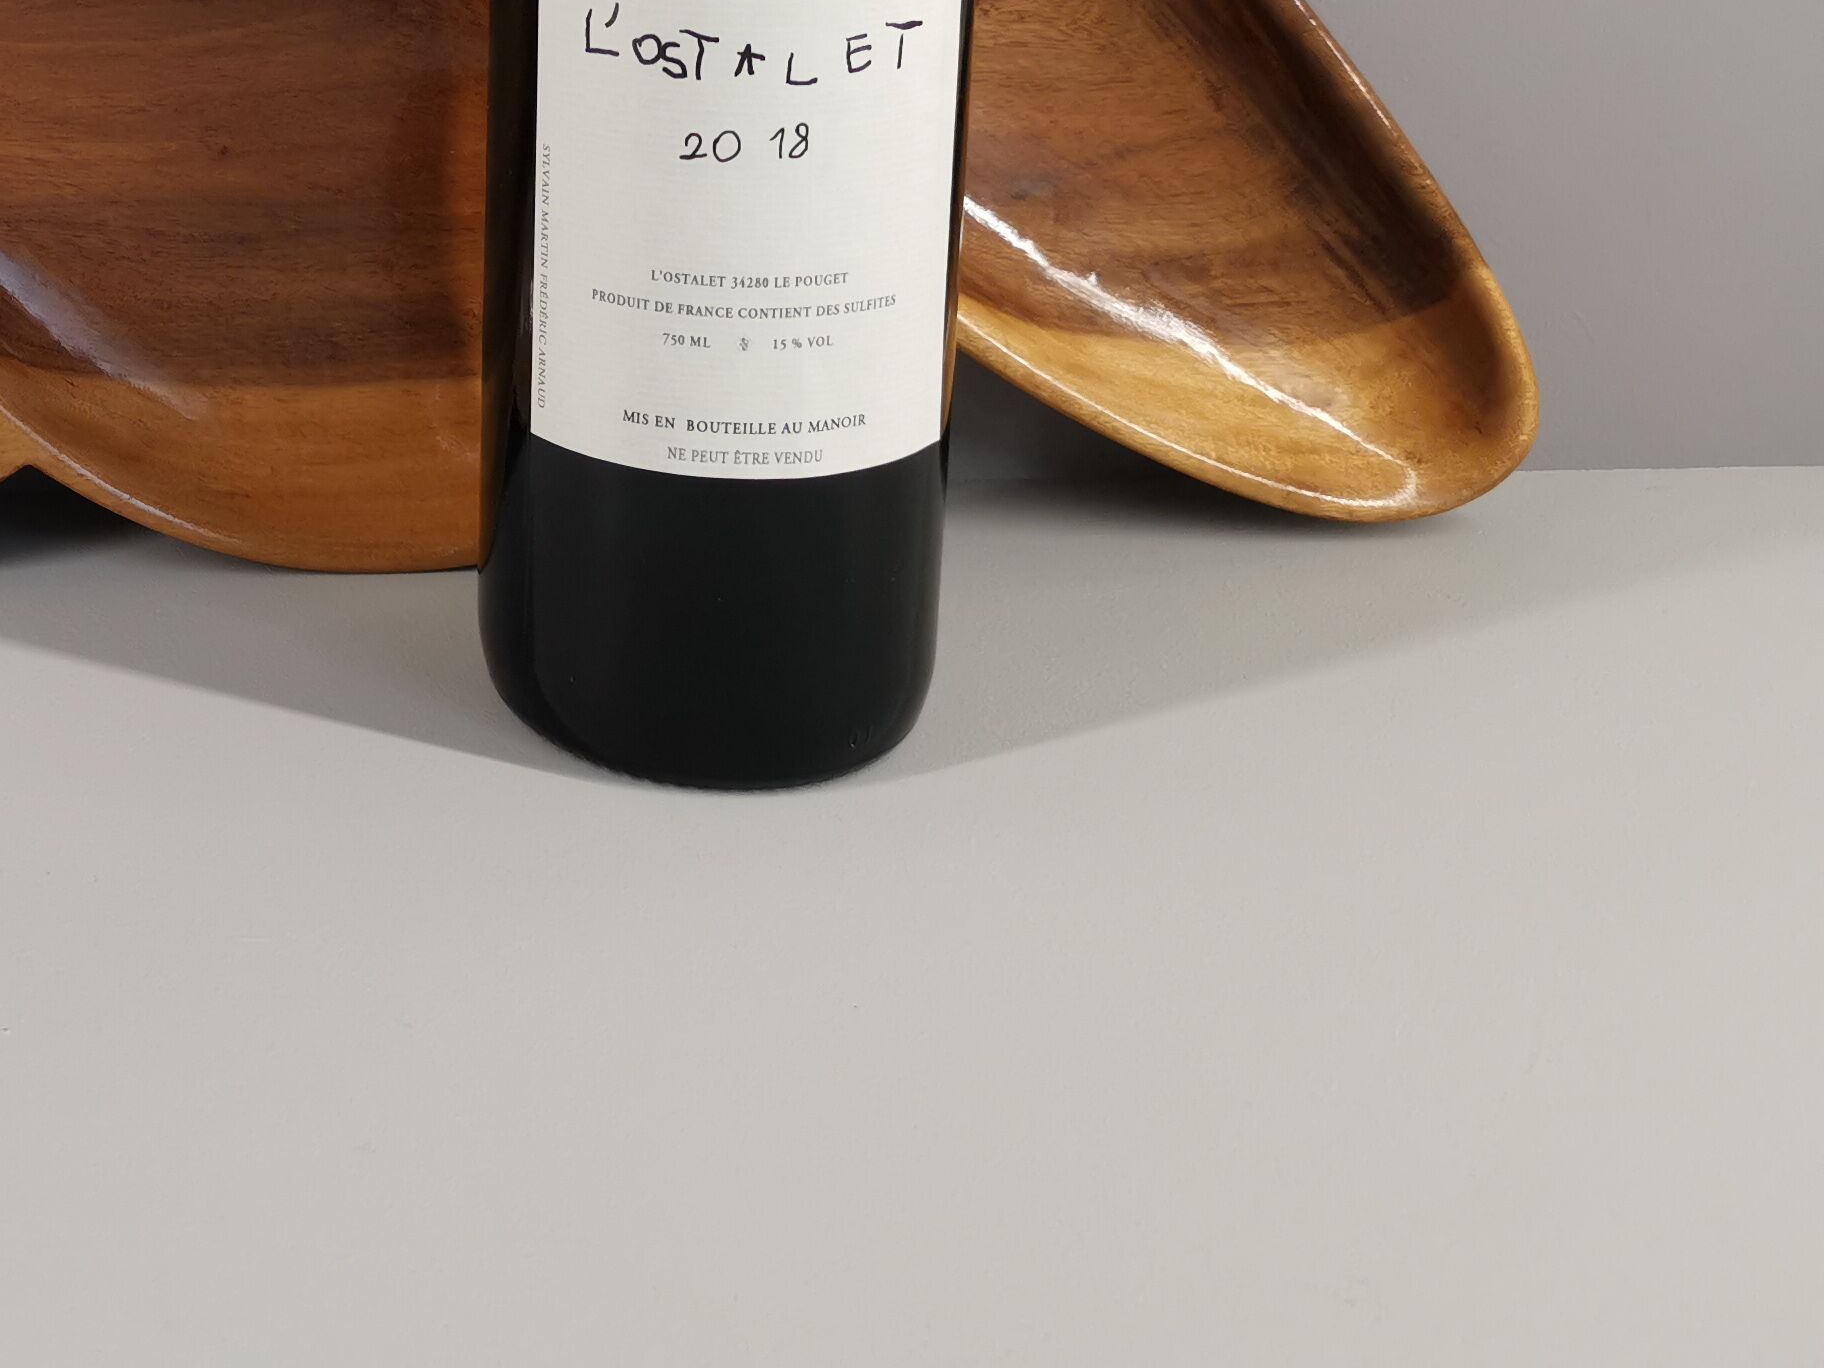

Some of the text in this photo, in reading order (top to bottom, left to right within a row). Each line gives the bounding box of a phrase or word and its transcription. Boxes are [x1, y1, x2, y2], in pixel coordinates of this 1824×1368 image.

[541, 143, 551, 206] SYLVAIN
[540, 208, 550, 269] MARTIN
[650, 269, 849, 290] L'OSTALET 34280 LE POUGET
[591, 288, 897, 320] PRODUIT DE FRANCE CONTIENT DES SULFITES
[662, 332, 711, 349] 750 ML
[773, 335, 834, 351] 15 % VOL
[537, 347, 547, 409] ARNAUD
[622, 408, 867, 436] MIS EN BOUTEILLE AU MANOIR
[667, 446, 824, 465] NE PEUT ÊTRE VENDU
